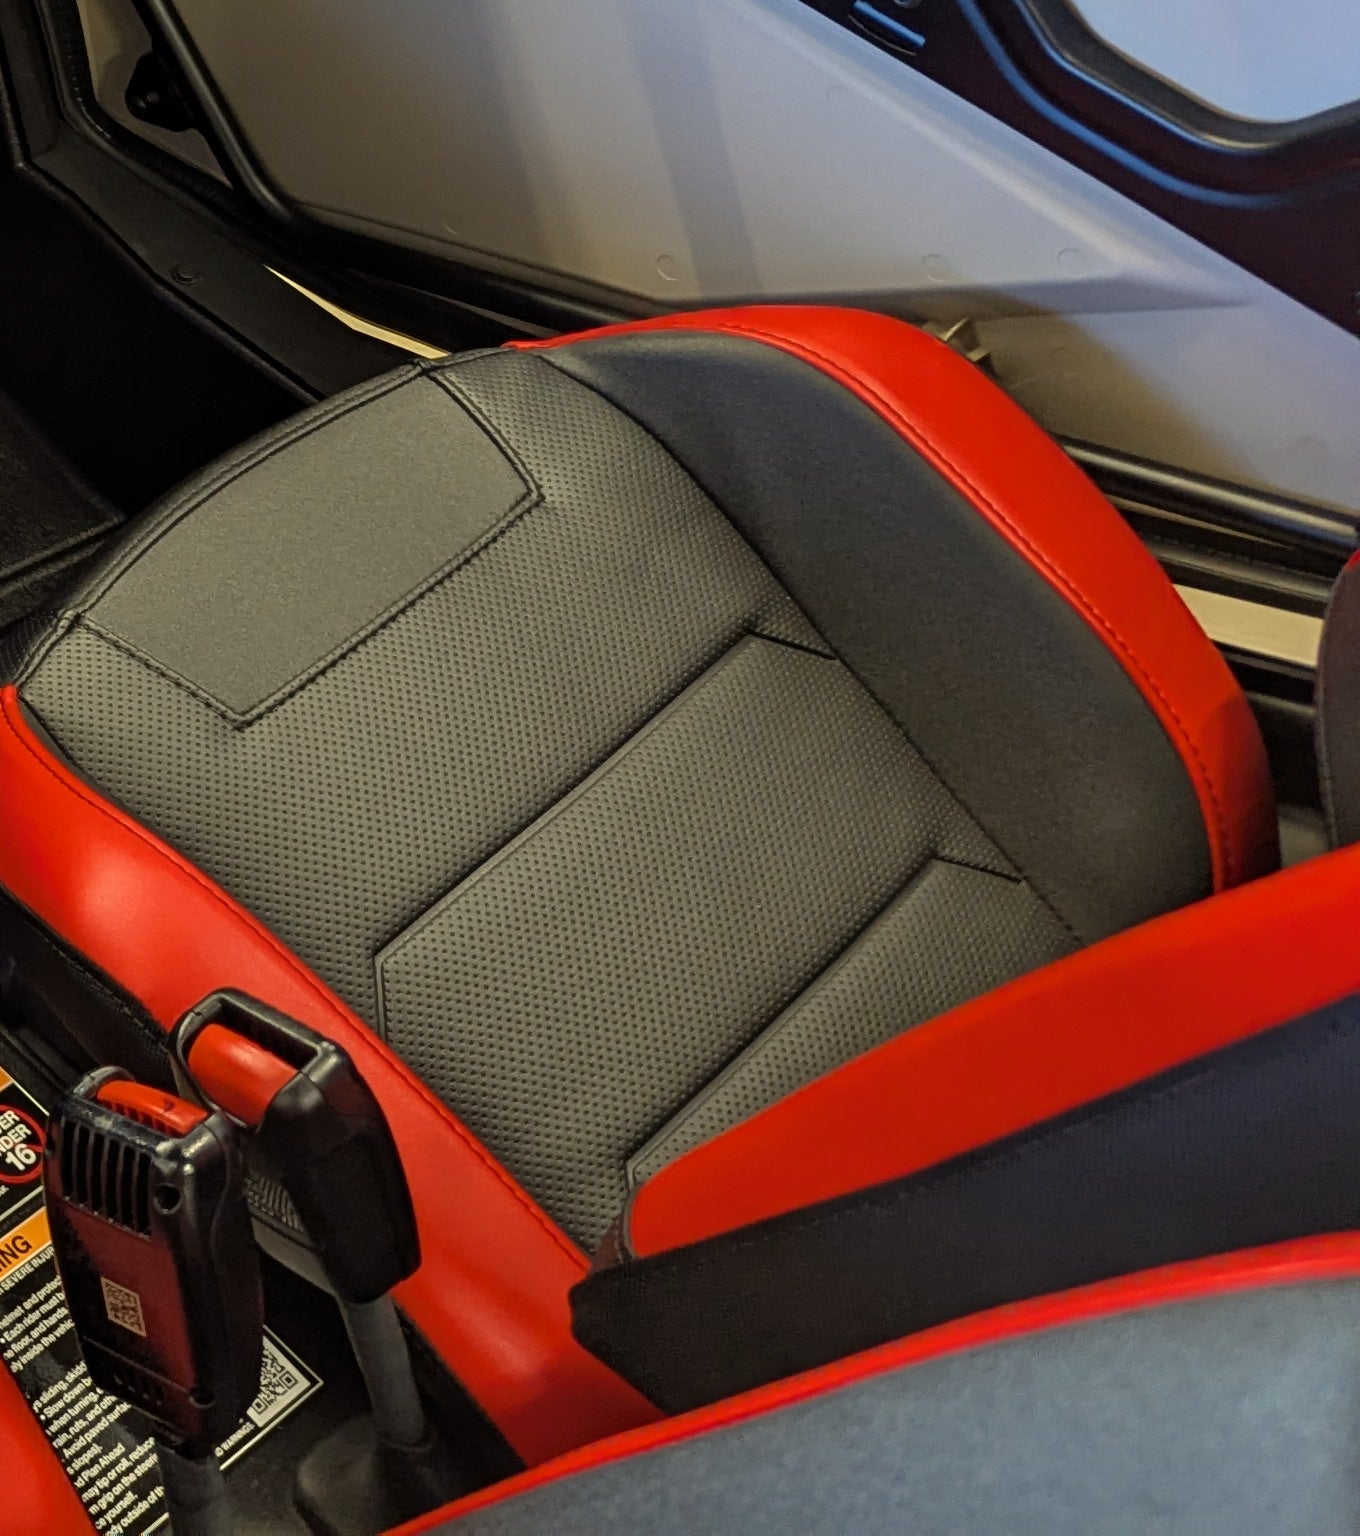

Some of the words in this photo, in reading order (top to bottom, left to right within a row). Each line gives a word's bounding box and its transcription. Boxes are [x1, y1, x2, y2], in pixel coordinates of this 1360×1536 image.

[5, 1142, 37, 1171] 16
[1, 1263, 35, 1292] SEVERE
[45, 1306, 70, 1329] hands
[3, 1322, 25, 1342] Each
[20, 1341, 45, 1364] inside
[40, 1380, 70, 1404] sliding,
[43, 1399, 66, 1418] Slow
[63, 1382, 86, 1403] down
[49, 1412, 72, 1433] when
[67, 1390, 100, 1416] turning,
[62, 1435, 87, 1459] Avoid
[84, 1417, 110, 1443] paved
[68, 1418, 90, 1436] ruts,
[81, 1463, 102, 1482] Plan
[99, 1442, 126, 1468] Ahead
[81, 1485, 100, 1503] may
[97, 1492, 115, 1511] grip
[104, 1490, 139, 1524] yourself.
[120, 1500, 151, 1528] outside
